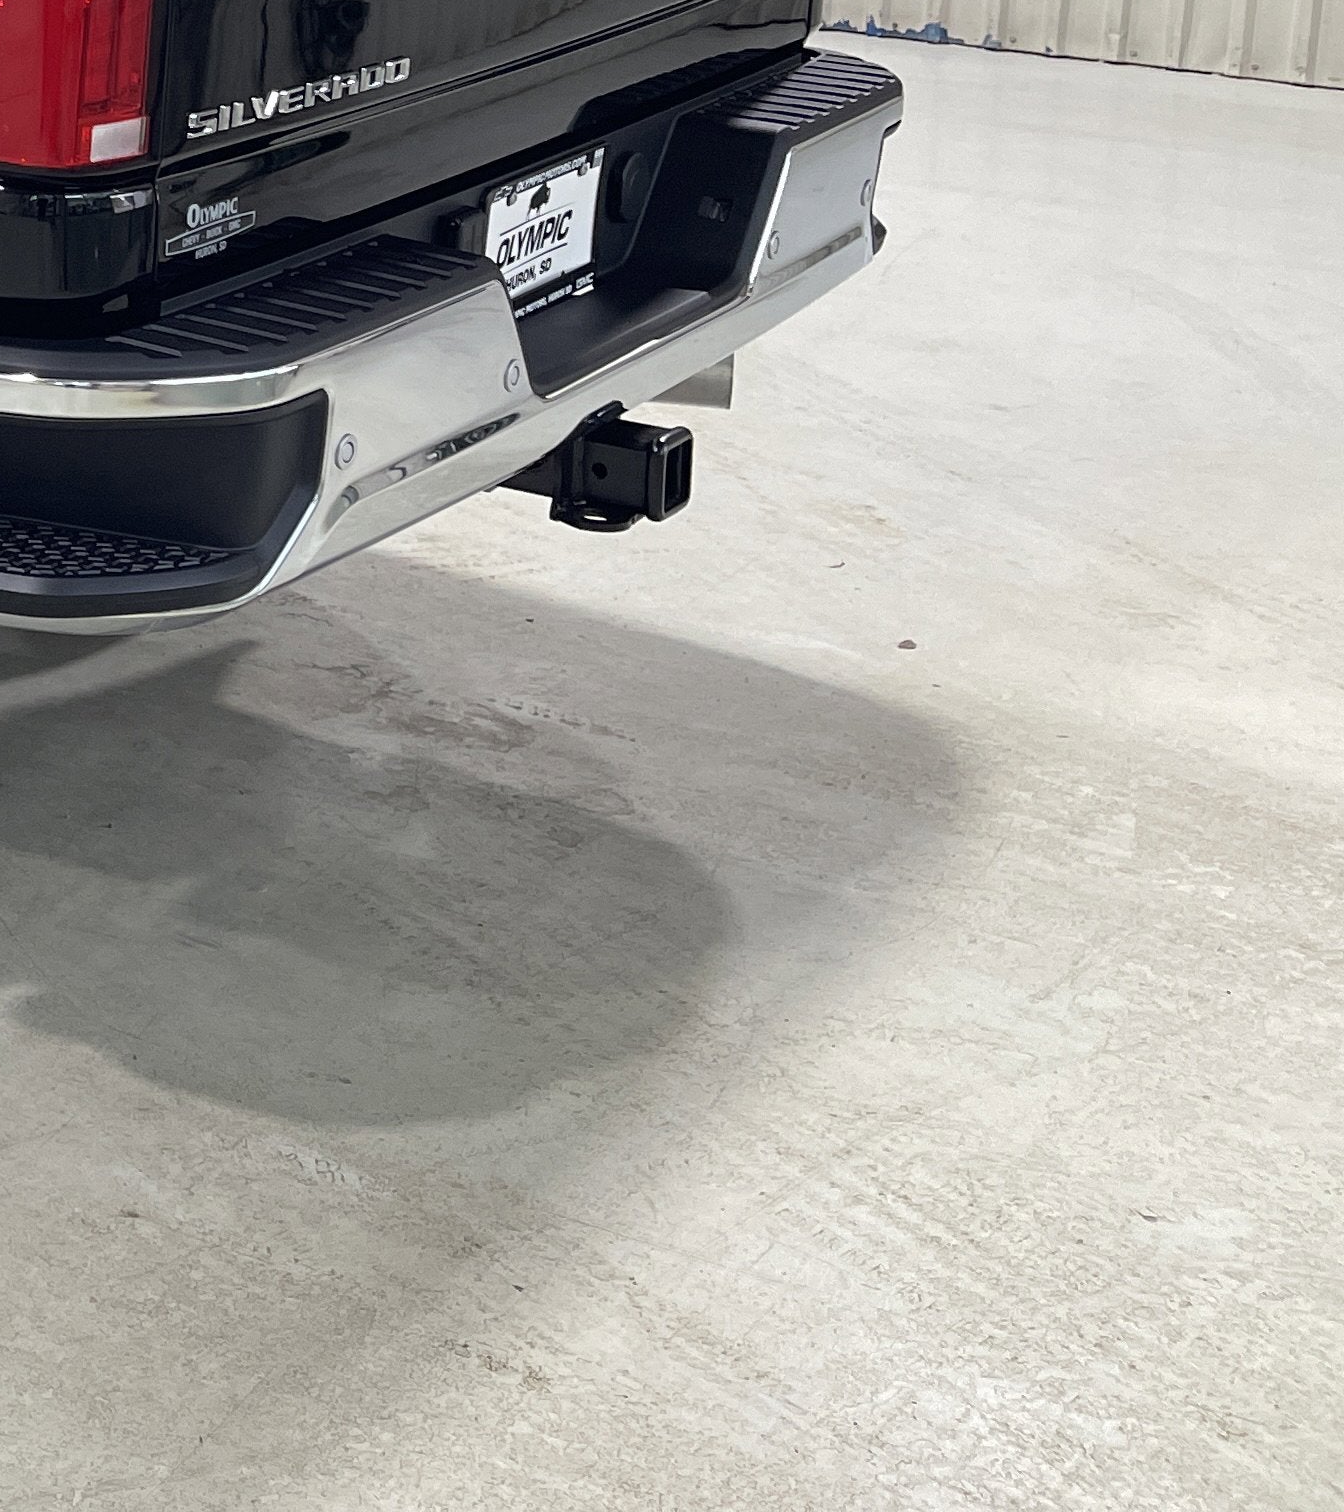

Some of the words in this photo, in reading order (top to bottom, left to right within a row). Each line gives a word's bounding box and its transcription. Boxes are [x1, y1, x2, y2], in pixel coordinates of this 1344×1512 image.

[187, 56, 411, 140] SILVERADO
[496, 209, 573, 268] OLYMPIC
[539, 257, 552, 275] SD
